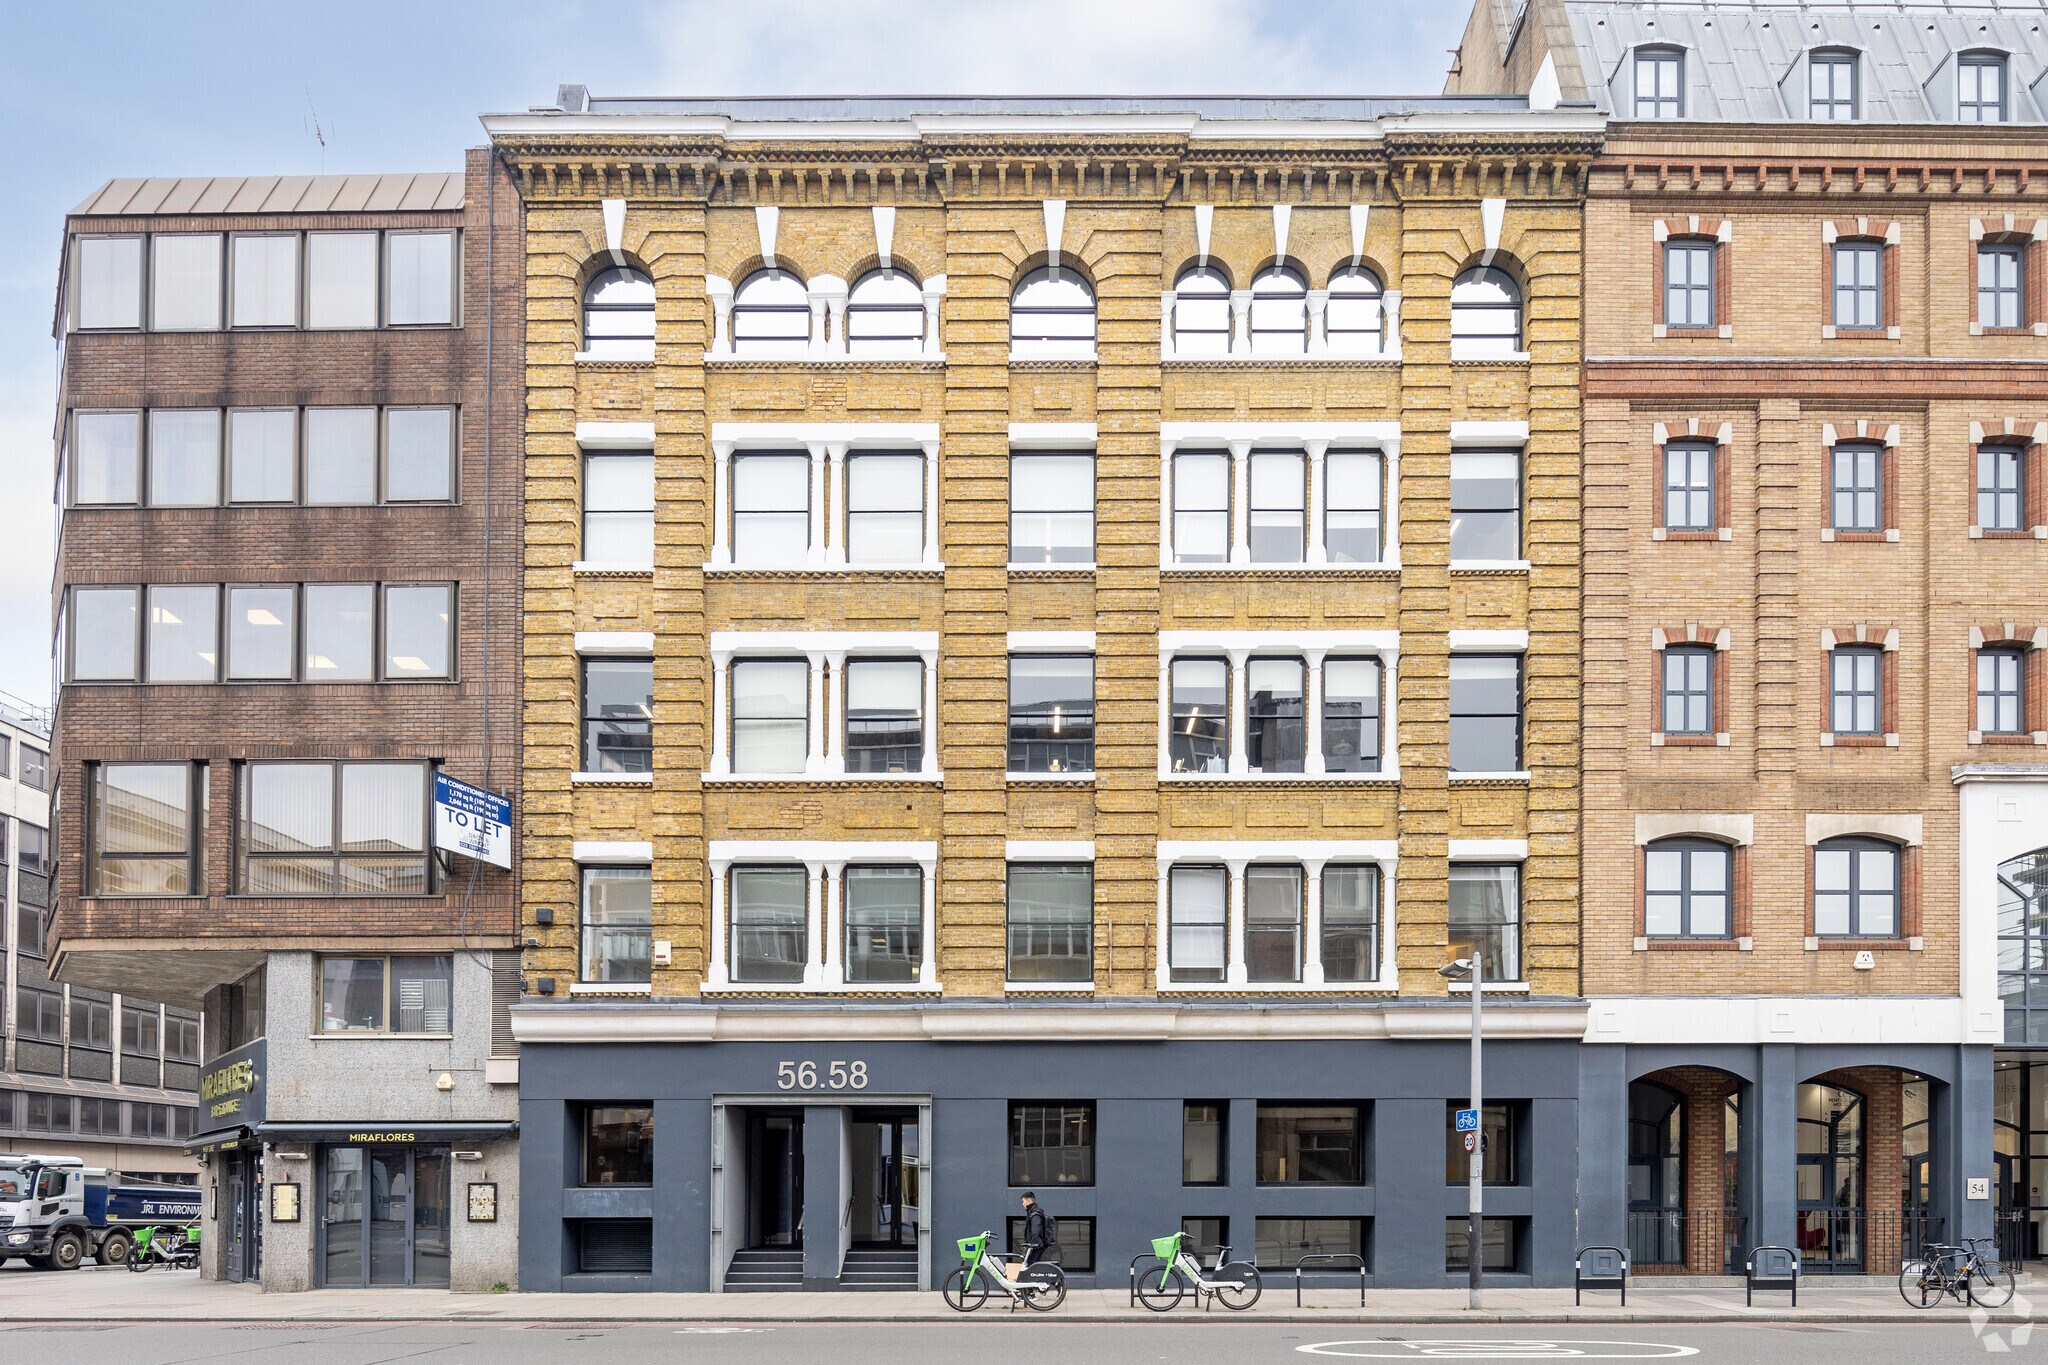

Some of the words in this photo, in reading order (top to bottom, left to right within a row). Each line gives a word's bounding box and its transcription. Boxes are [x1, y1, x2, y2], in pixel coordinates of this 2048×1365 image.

[438, 776, 447, 785] AIR
[487, 795, 510, 808] OFFICES
[445, 807, 468, 827] TO
[474, 817, 502, 838] LET
[777, 1060, 868, 1090] 56.58
[349, 1132, 415, 1142] MIRAFLORES
[1466, 1137, 1474, 1147] 20
[1971, 1183, 1985, 1194] 54
[141, 1204, 156, 1214] JRL
[158, 1205, 202, 1214] ENVIRONM
